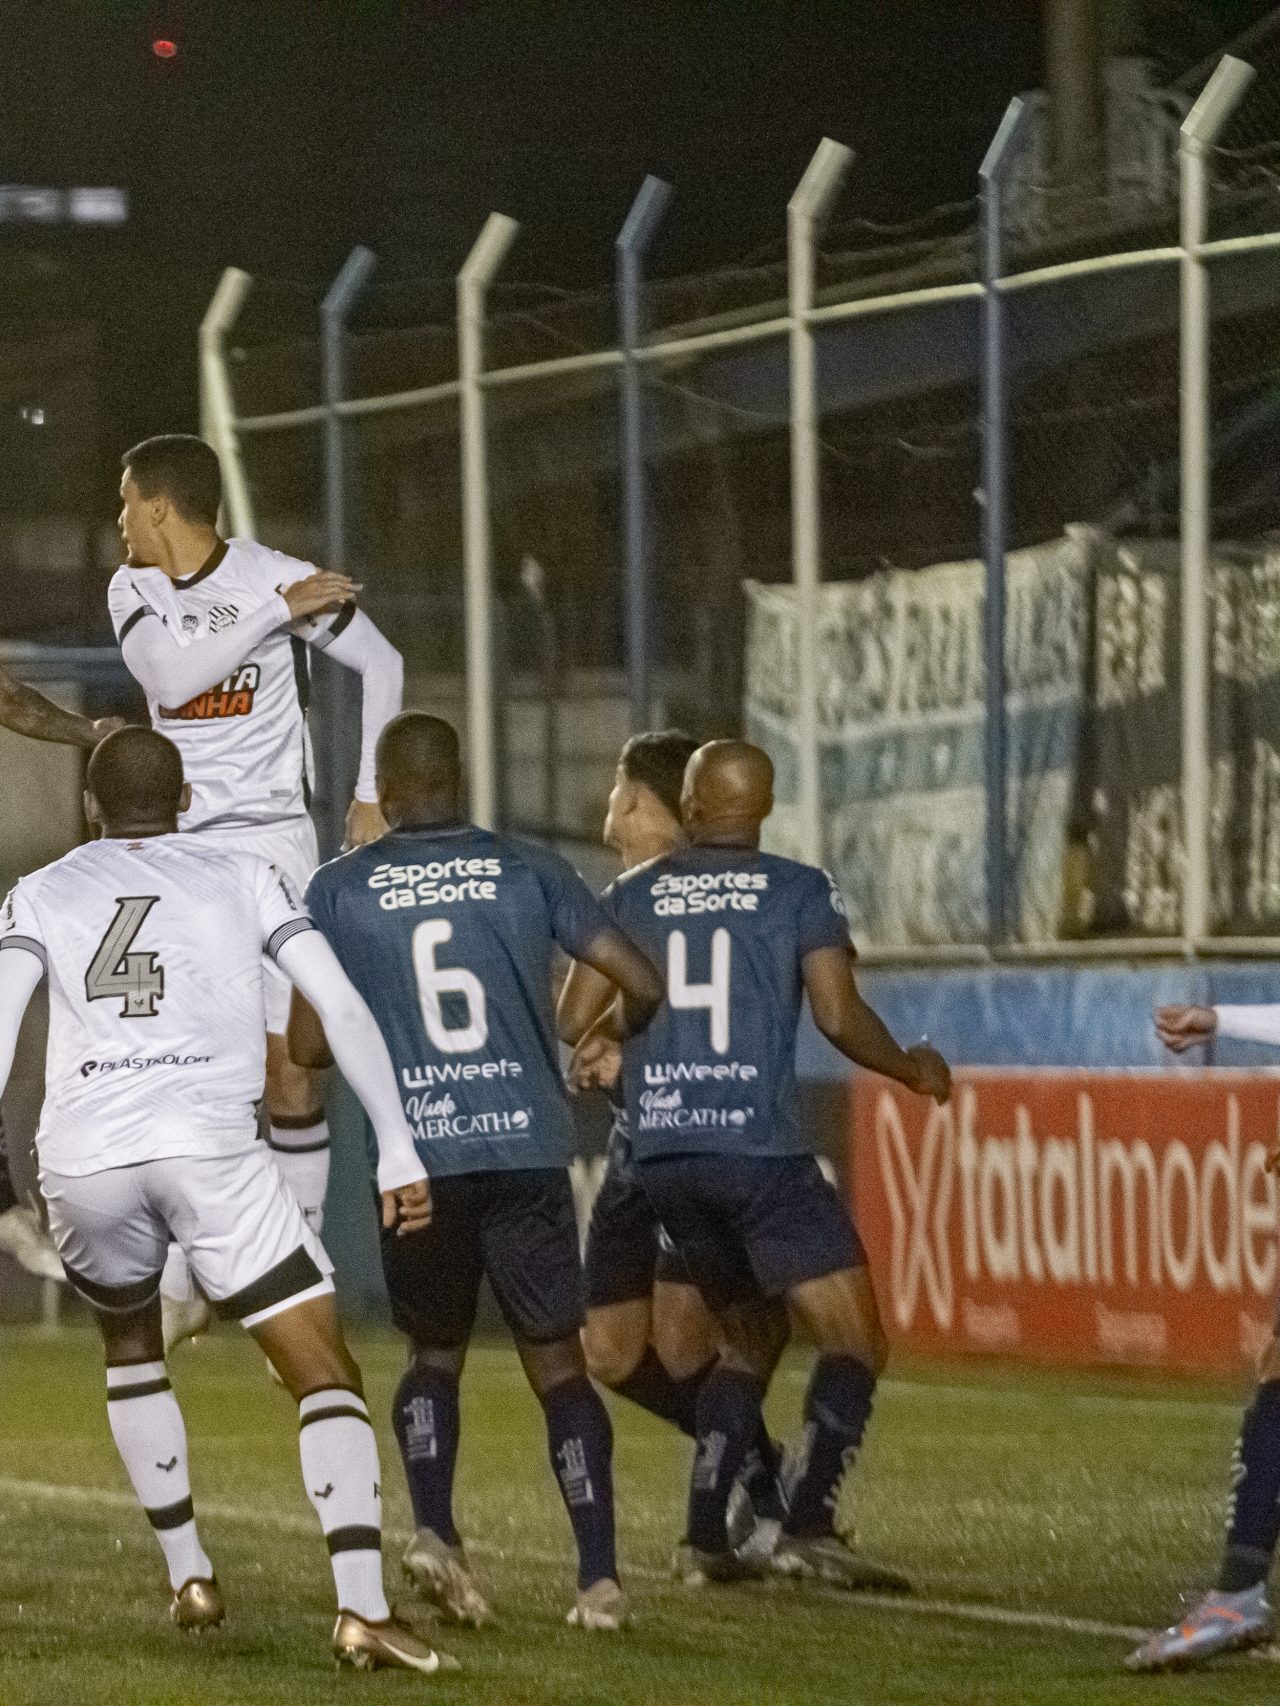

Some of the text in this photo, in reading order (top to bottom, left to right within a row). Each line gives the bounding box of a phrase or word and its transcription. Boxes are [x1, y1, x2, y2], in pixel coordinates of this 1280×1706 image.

[368, 858, 502, 888] Esportes
[650, 871, 768, 896] Esportes
[85, 896, 164, 1018] 4
[412, 919, 488, 1053] 6
[667, 928, 731, 1055] 4
